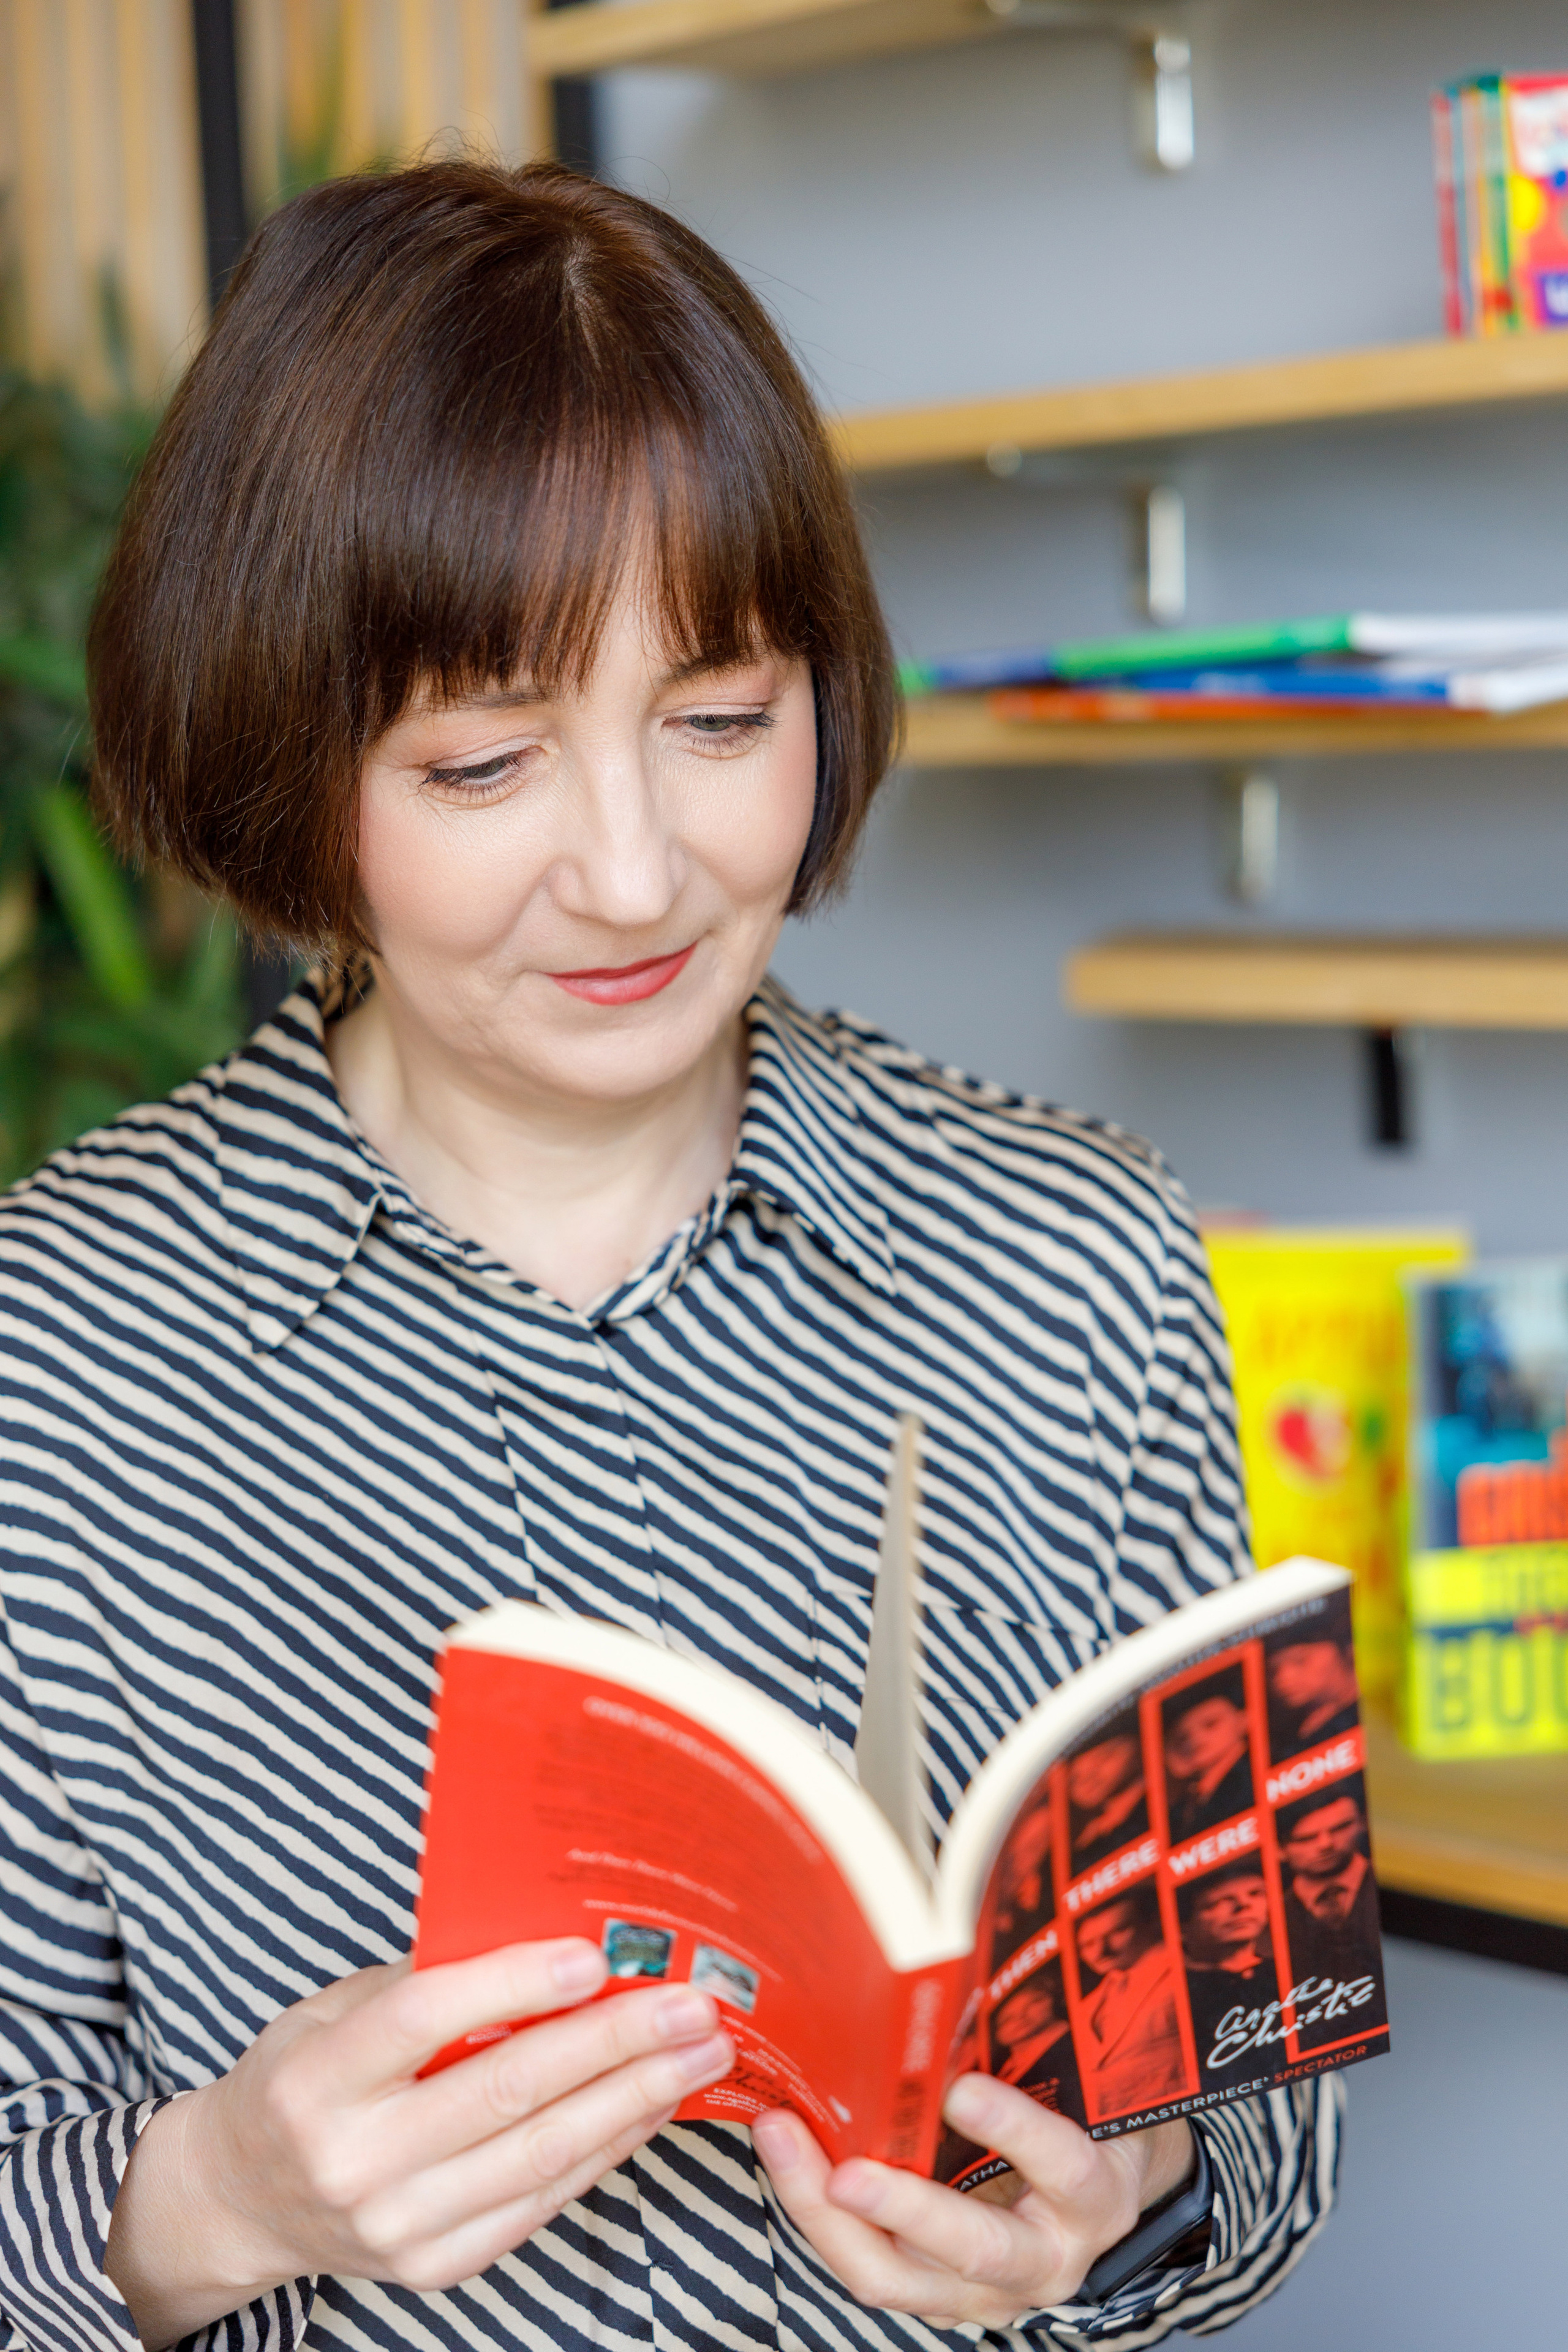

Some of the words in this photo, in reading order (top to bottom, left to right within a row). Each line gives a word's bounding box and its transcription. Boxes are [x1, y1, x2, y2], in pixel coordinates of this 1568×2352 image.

[986, 1929, 1058, 2000] THEN
[1062, 1838, 1161, 1911] THERE
[1168, 1817, 1261, 1875] WERE
[1265, 1738, 1357, 1803] NONE
[1206, 1975, 1376, 2069] Christie
[1215, 1975, 1334, 2040] Agatha
[713, 2087, 758, 2103] EXPLORE
[954, 2160, 1009, 2192] ATHA
[1274, 2045, 1368, 2084] SPECTATOR
